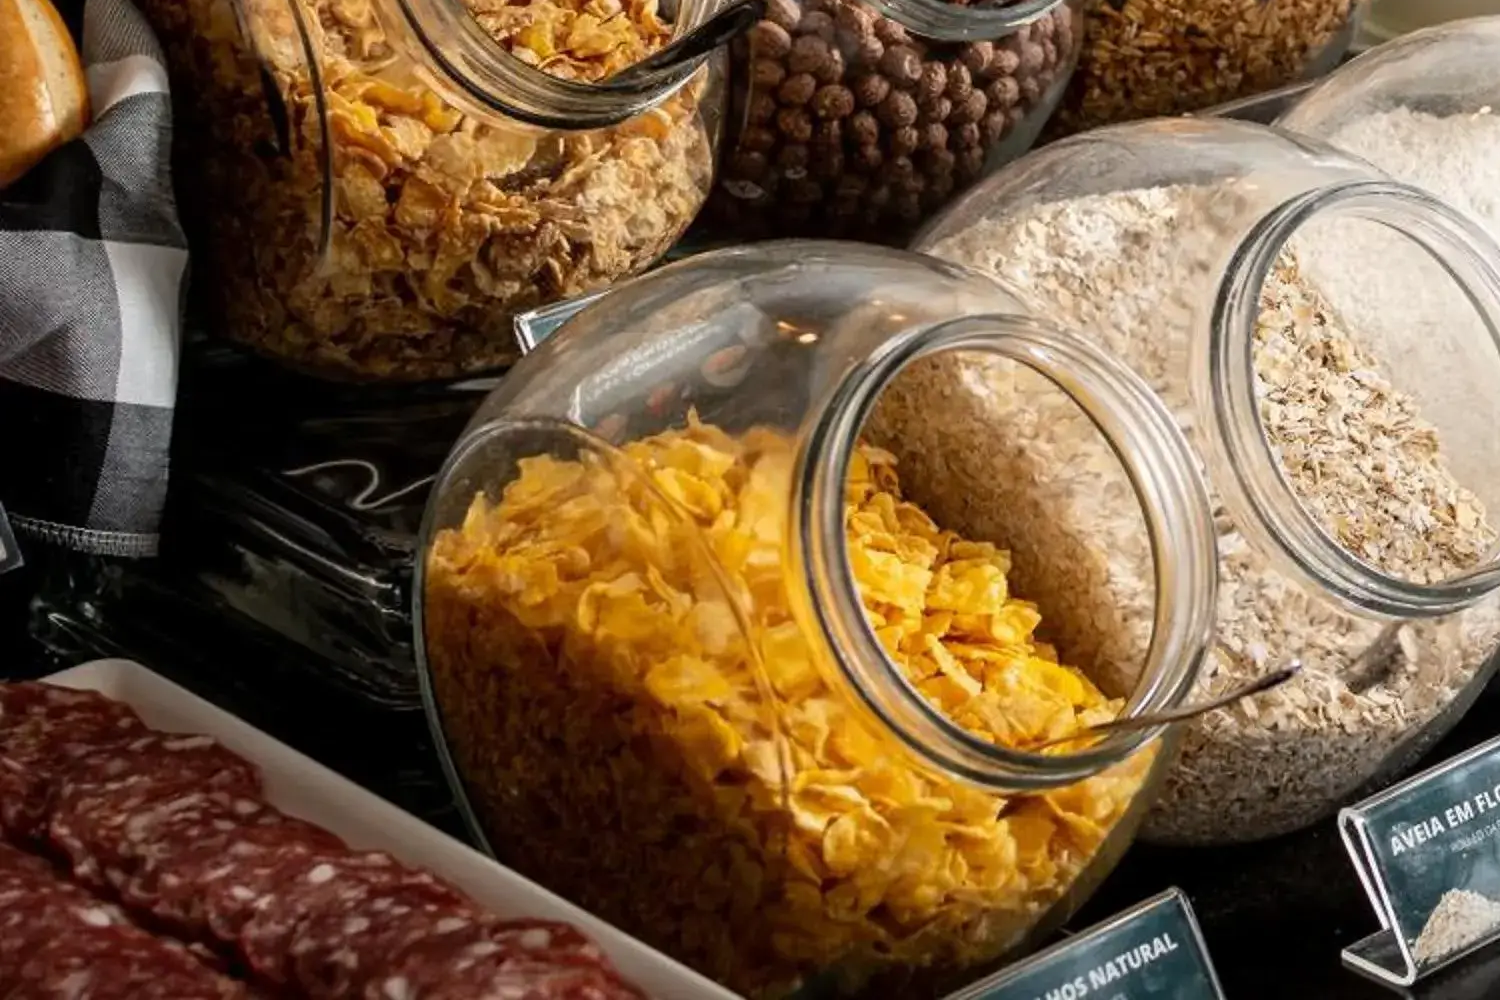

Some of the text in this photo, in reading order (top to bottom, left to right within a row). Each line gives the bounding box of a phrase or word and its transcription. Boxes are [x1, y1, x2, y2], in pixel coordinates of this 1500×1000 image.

[1391, 815, 1445, 857] AVEIA
[1445, 800, 1475, 829] EM
[1034, 932, 1179, 1000] HOS NATURAL
